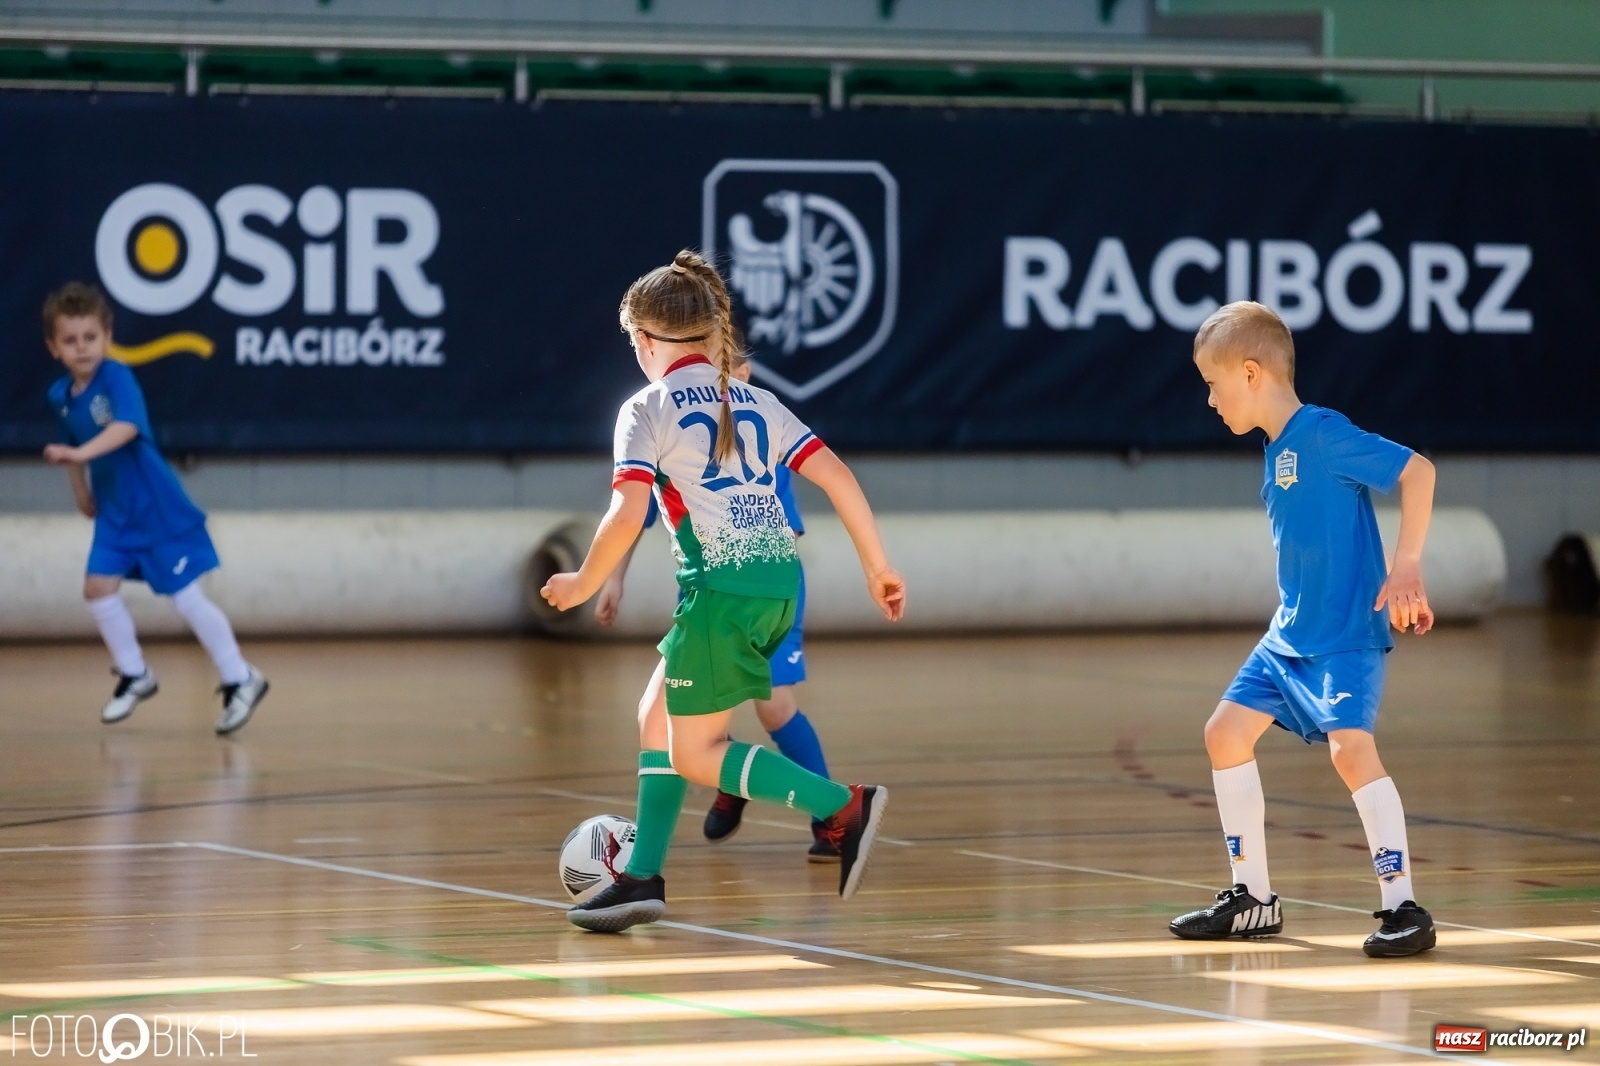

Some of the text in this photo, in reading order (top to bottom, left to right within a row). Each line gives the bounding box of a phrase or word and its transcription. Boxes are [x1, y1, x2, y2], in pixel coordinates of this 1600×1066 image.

[95, 182, 444, 317] OSiR
[1003, 209, 1533, 333] RACIBÓRZ
[236, 318, 445, 366] RACIBÓRZ
[671, 386, 757, 409] PAULNA
[678, 410, 773, 492] 20
